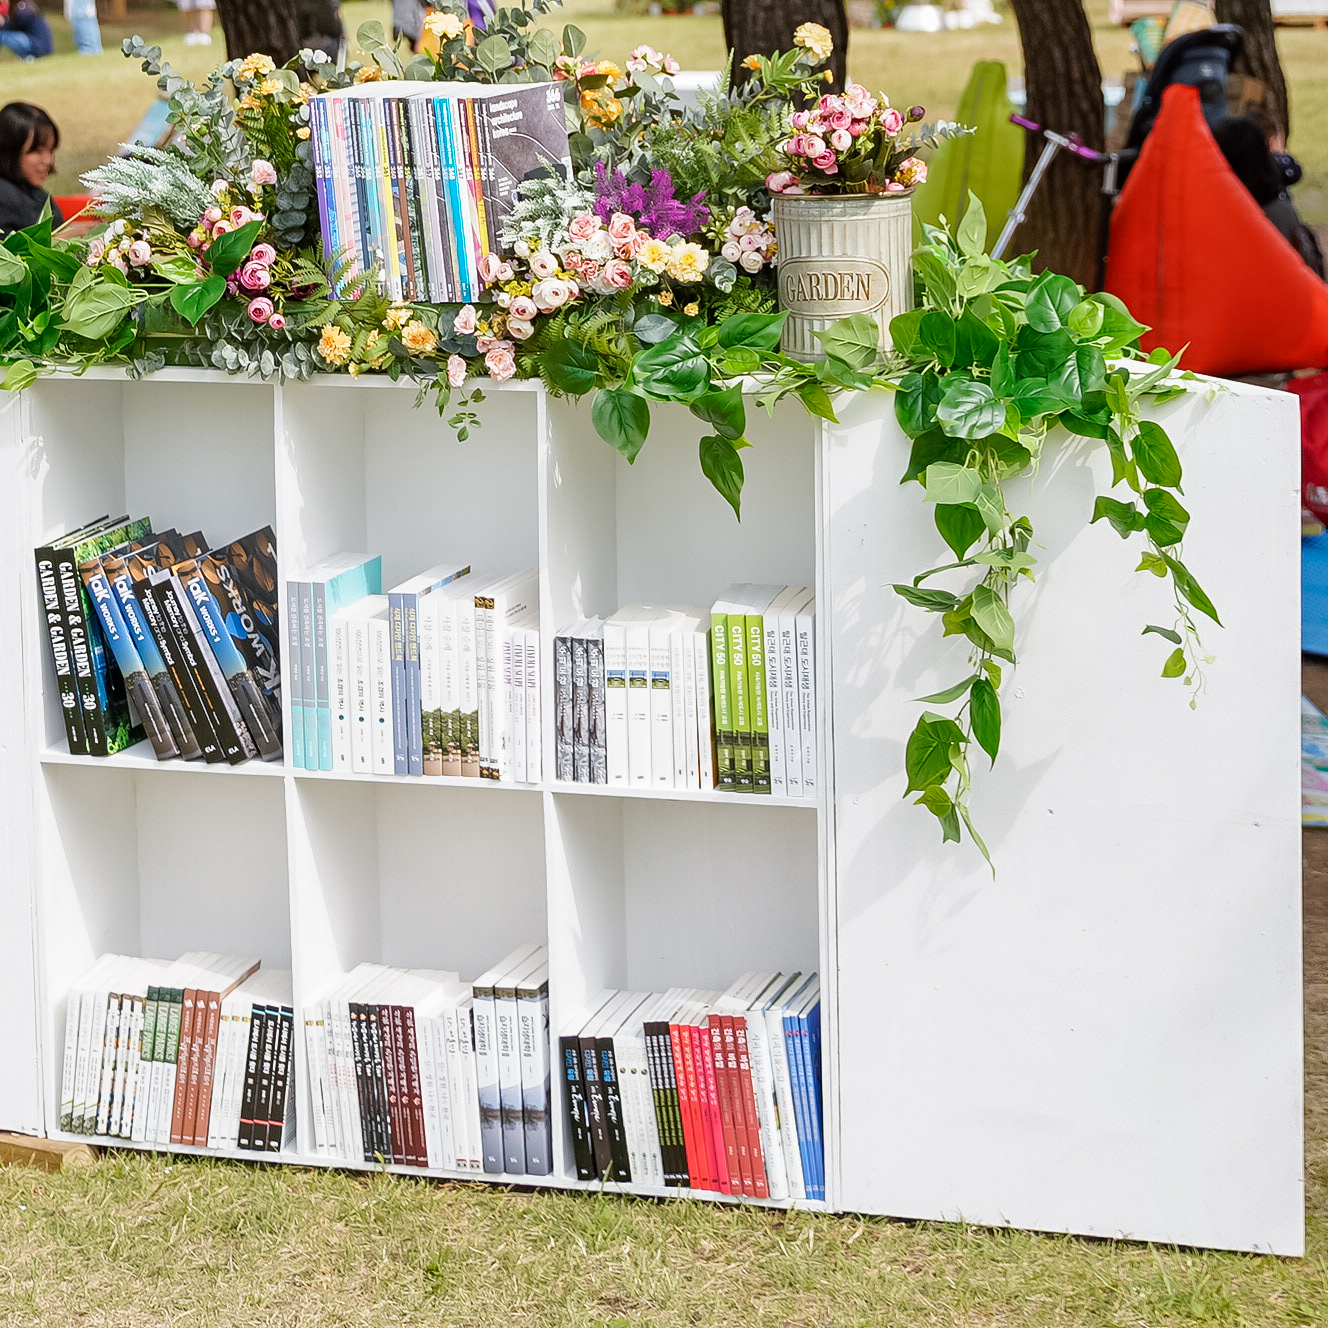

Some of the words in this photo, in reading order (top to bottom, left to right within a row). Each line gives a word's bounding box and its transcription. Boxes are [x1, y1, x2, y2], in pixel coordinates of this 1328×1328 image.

[786, 273, 871, 302] GARDEN
[39, 560, 59, 609] GARDEN
[59, 562, 77, 611] GARDEN
[142, 598, 157, 626] Memory
[144, 589, 160, 614] Journey
[164, 600, 178, 628] Memory
[166, 590, 181, 616] Journey
[216, 564, 266, 658] WORKS
[48, 613, 61, 623] &
[69, 615, 82, 625] &
[101, 603, 116, 633] WORKS
[125, 604, 141, 634] WORKS
[200, 606, 217, 637] WORKS
[50, 627, 70, 675] GARDEN
[714, 625, 725, 651] CITY
[732, 626, 743, 651] CITY
[751, 627, 761, 652] CITY
[70, 628, 91, 677] GARDEN
[61, 692, 75, 708] 30
[83, 694, 97, 710] 30
[144, 1006, 155, 1031] LARGE
[156, 1007, 167, 1032] LARGE
[168, 1008, 178, 1033] LARGE
[142, 1032, 152, 1059] PARKS
[154, 1033, 165, 1059] PARKS
[165, 1034, 176, 1061] PARKS
